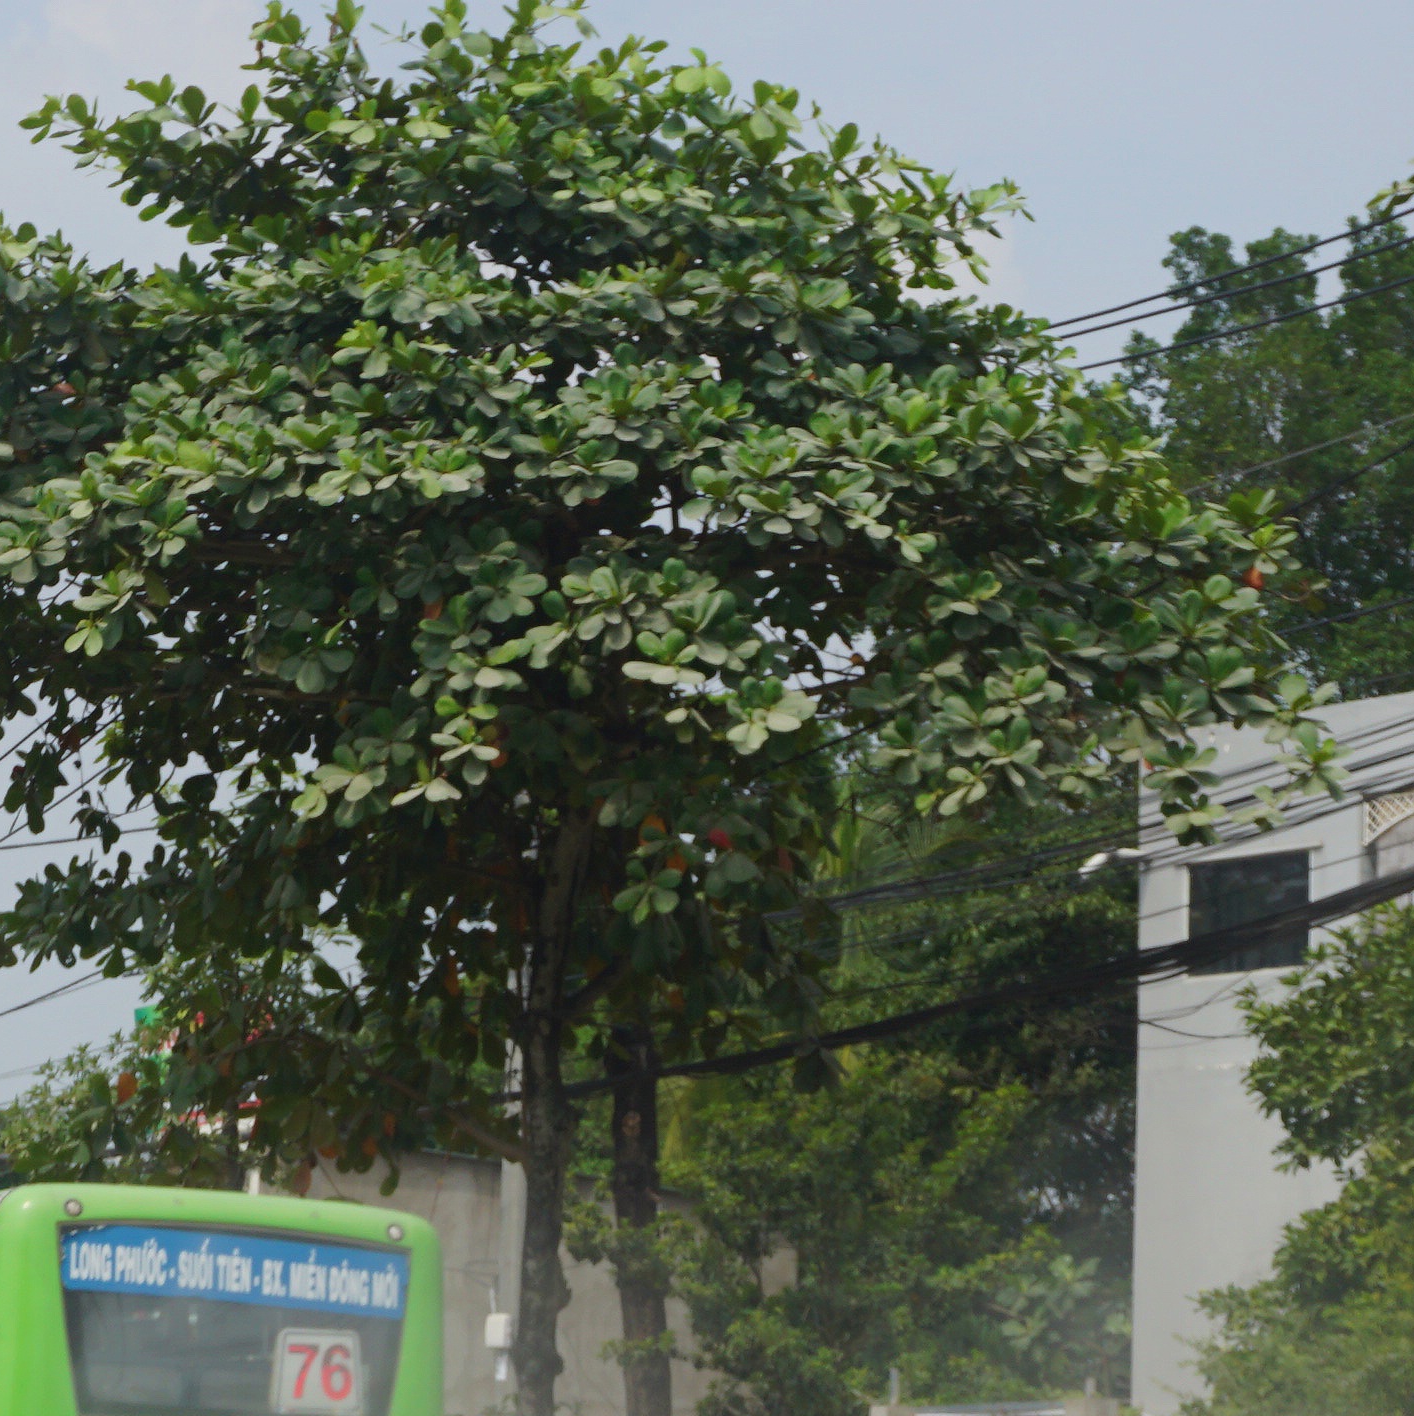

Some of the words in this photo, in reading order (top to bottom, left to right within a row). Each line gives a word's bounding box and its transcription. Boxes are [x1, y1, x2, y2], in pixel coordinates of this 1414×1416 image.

[70, 1242, 112, 1281] LONG
[115, 1238, 167, 1286] PHƯỚC
[217, 1247, 252, 1294] TIÊN
[262, 1259, 286, 1298] BX.
[287, 1344, 353, 1401] 76
